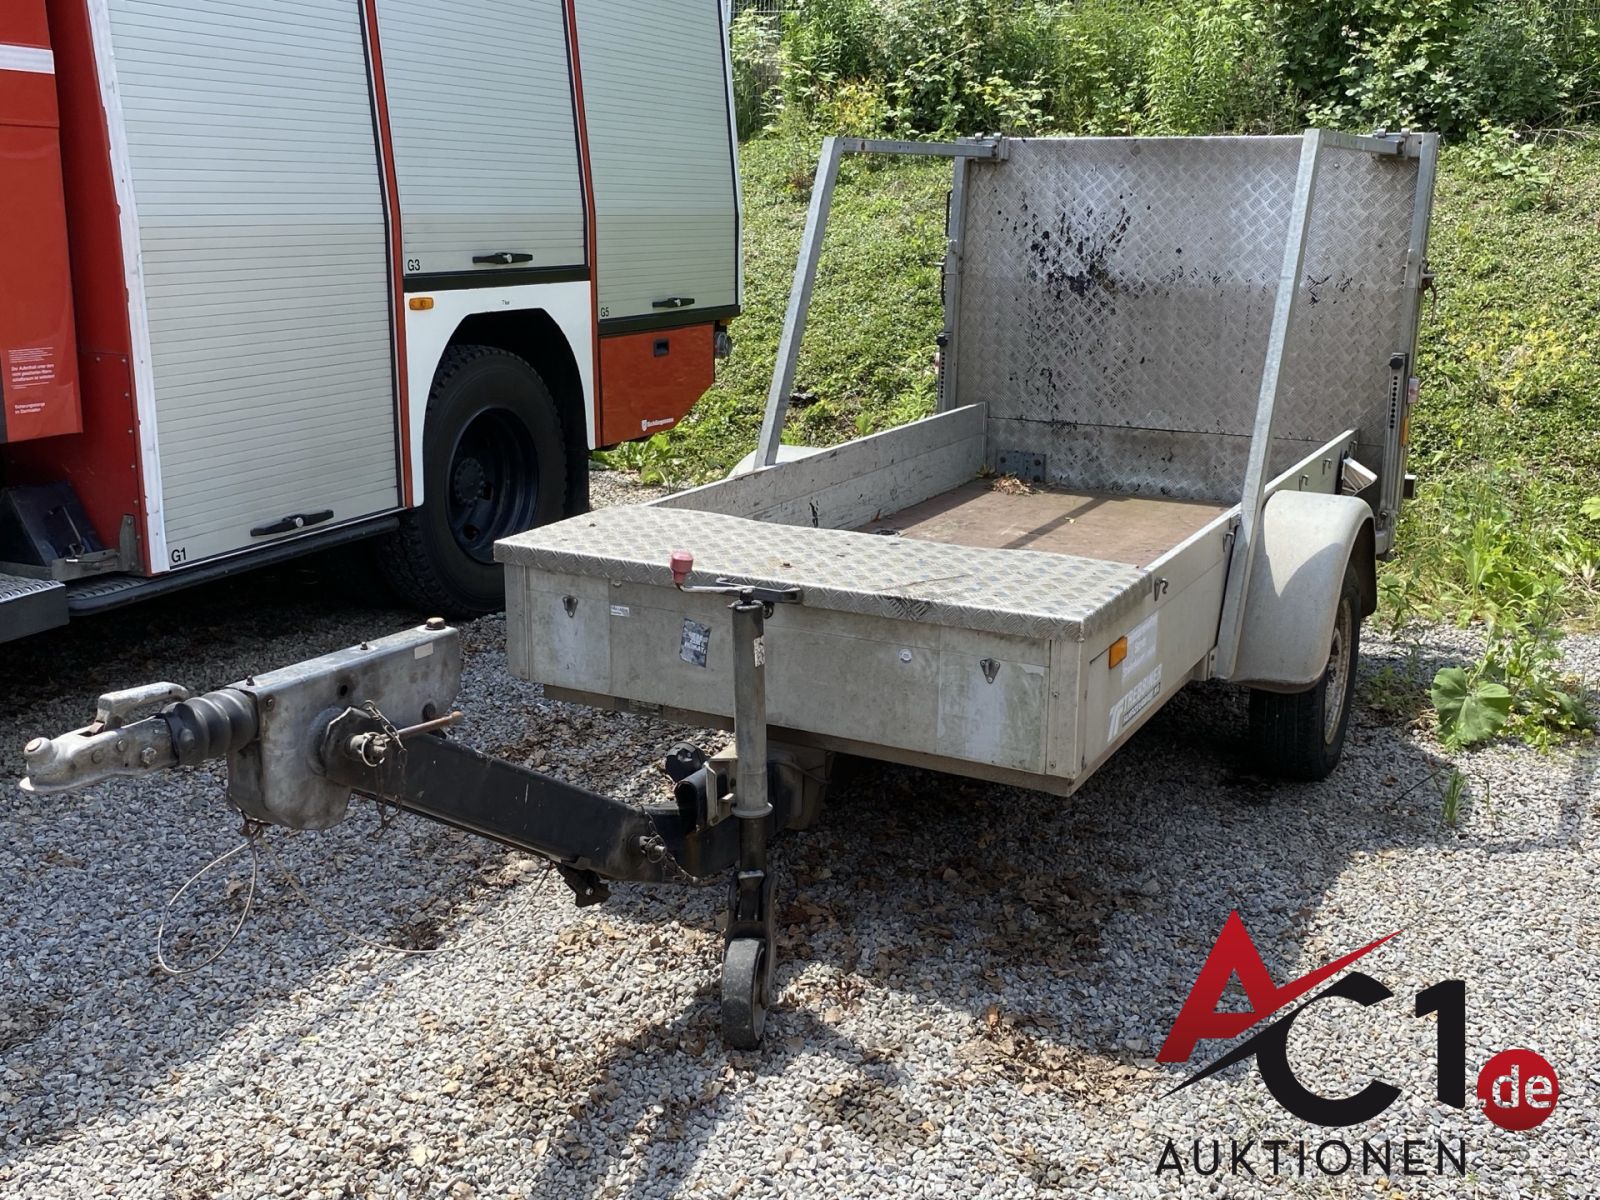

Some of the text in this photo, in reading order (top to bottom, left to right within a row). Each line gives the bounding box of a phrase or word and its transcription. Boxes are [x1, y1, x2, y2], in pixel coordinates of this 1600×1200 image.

[407, 258, 420, 271] G3
[601, 306, 609, 317] G5
[171, 547, 186, 563] G1
